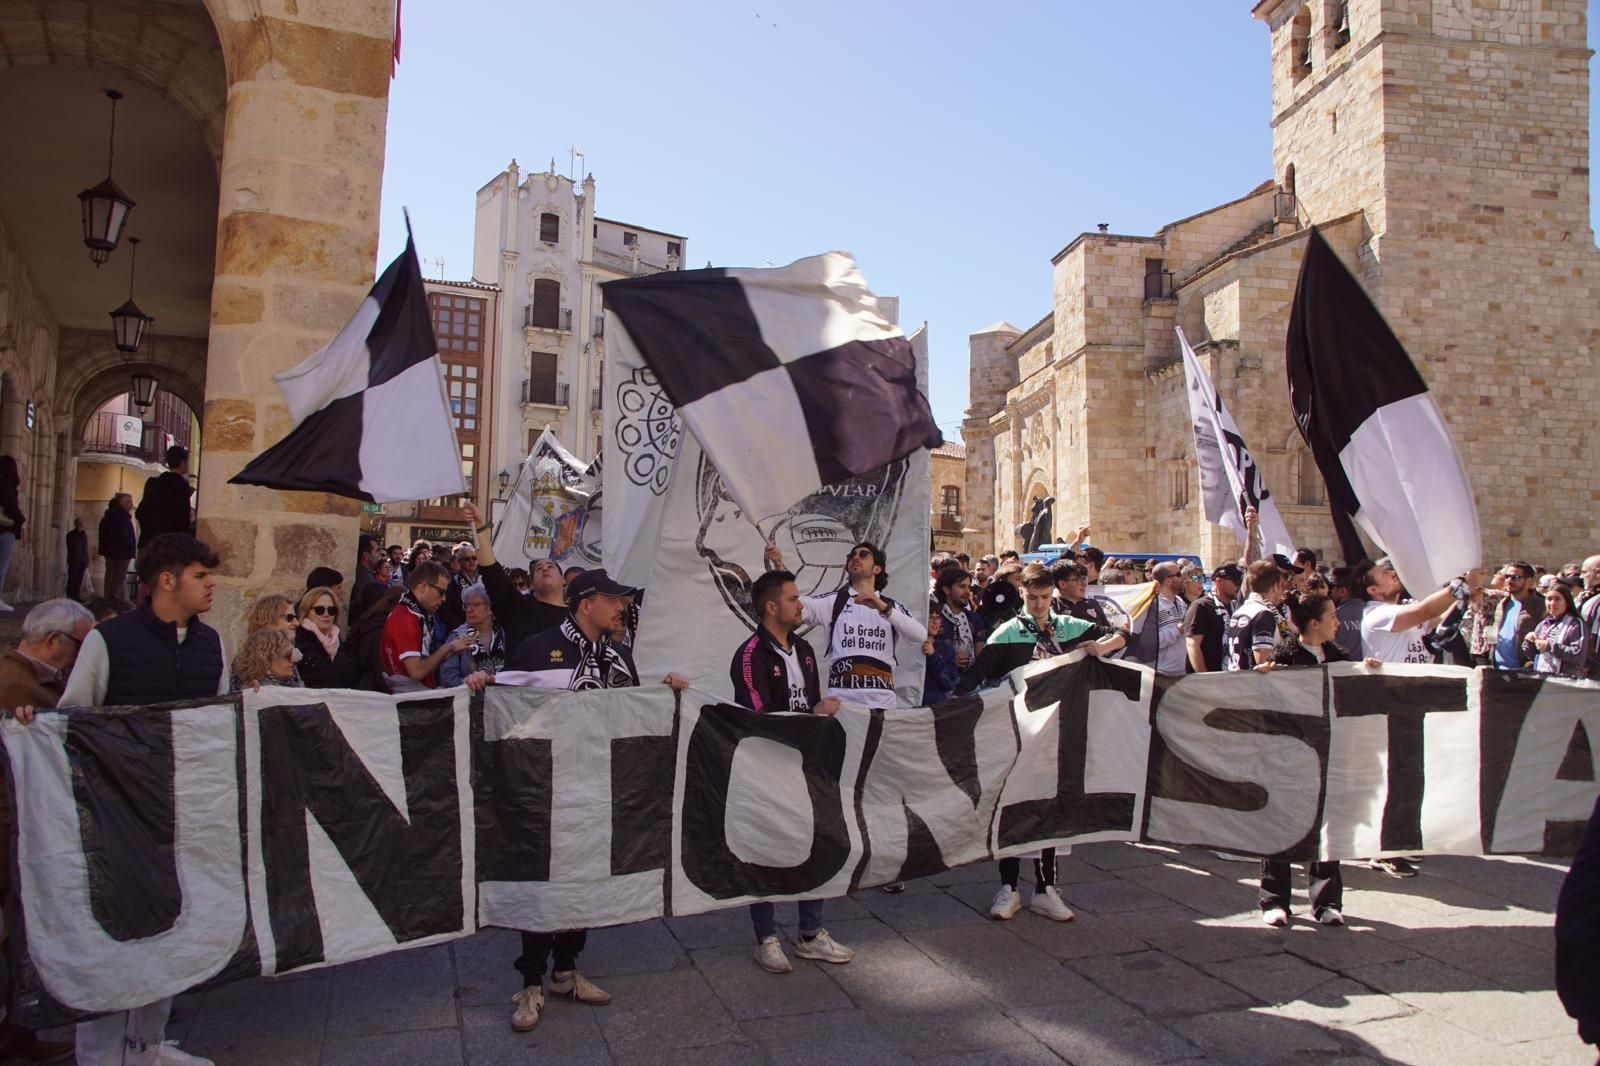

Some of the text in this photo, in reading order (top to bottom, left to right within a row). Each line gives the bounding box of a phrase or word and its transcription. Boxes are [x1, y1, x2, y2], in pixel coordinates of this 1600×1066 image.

[843, 623, 886, 638] La Grada
[841, 636, 856, 648] del
